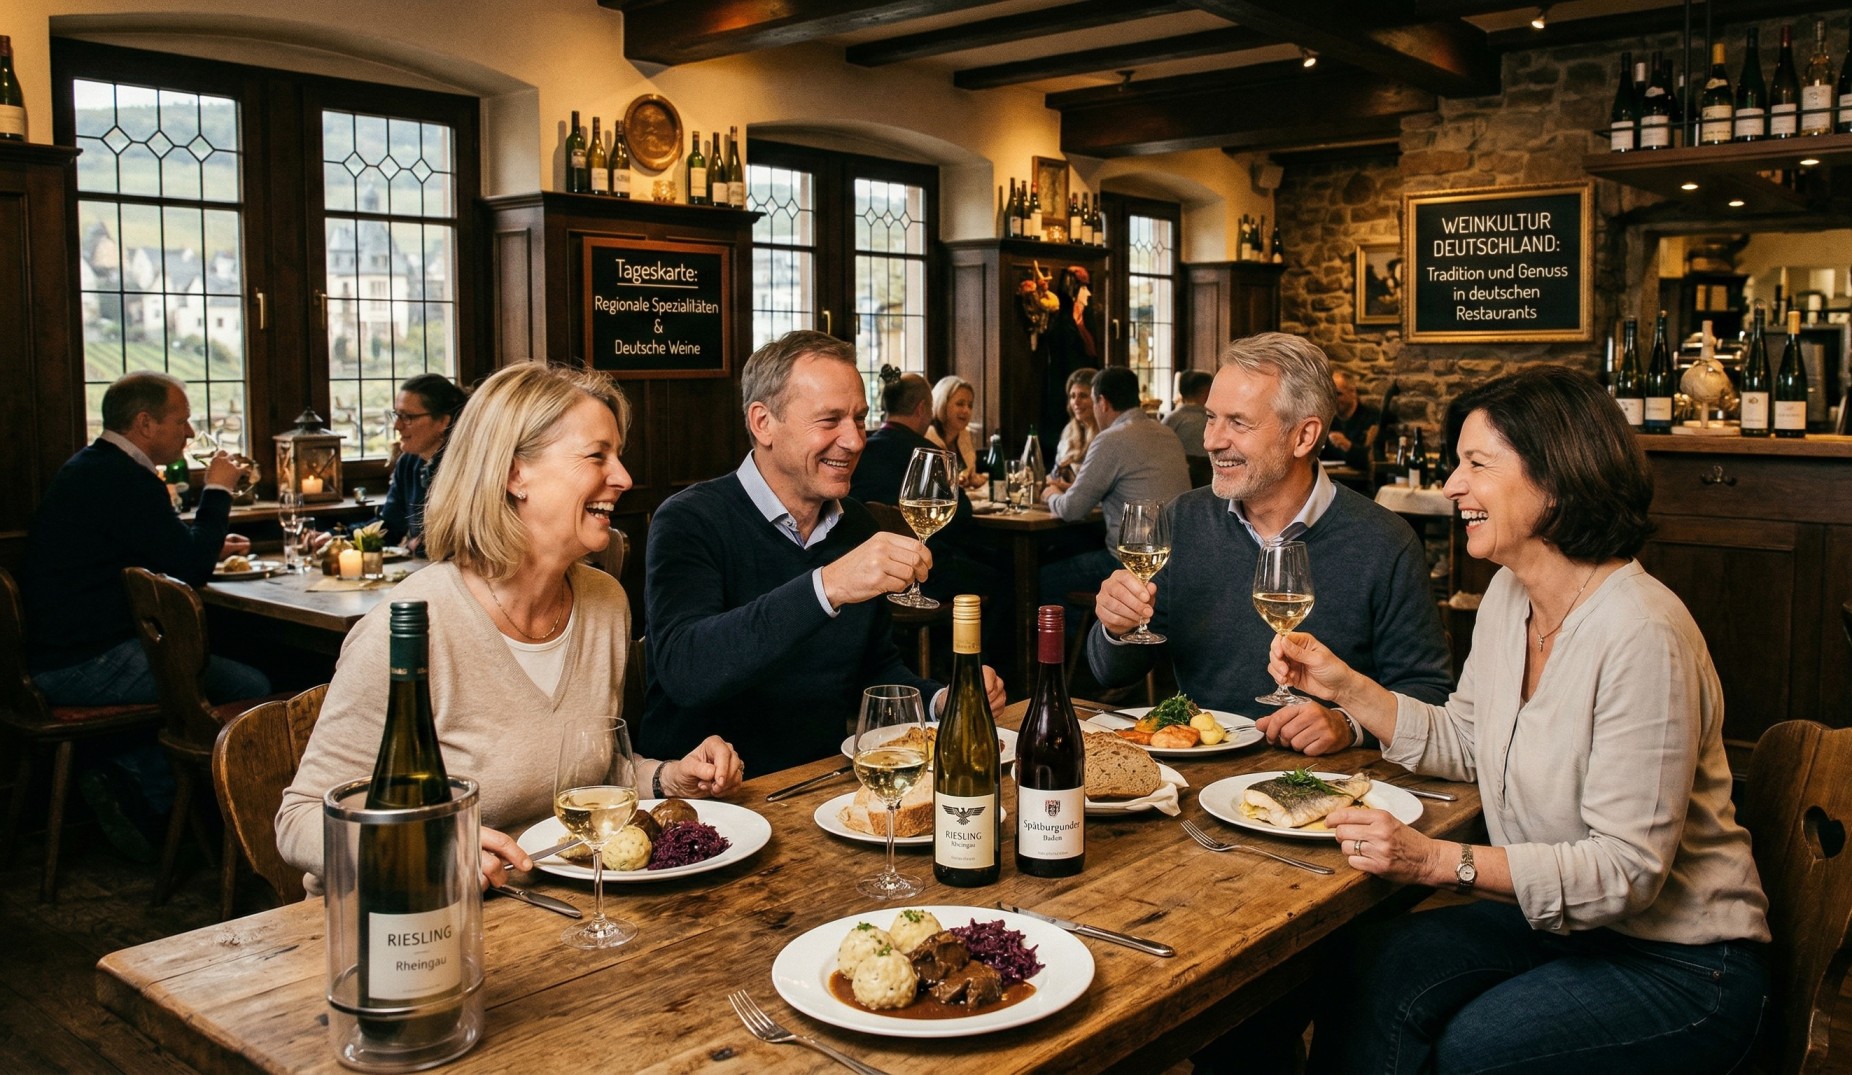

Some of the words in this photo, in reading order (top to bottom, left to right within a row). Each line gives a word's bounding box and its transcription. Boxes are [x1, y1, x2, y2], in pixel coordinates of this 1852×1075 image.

[1442, 212, 1550, 234] WEINKULTUR
[1434, 235, 1559, 257] DEUTSCHLAND:
[616, 258, 698, 284] Tageskarte:
[1427, 266, 1484, 281] Tradition
[1488, 264, 1514, 279] und
[1519, 264, 1568, 278] Genuss
[1454, 287, 1465, 300] in
[1469, 284, 1539, 300] deutschen
[595, 296, 649, 314] Regionale
[652, 298, 718, 315] Spezialitäten
[1457, 305, 1537, 320] Restaurants
[654, 319, 663, 333] &
[616, 340, 665, 354] Deutsche
[669, 341, 700, 354] Weine
[1023, 819, 1081, 834] Spätburgunder
[945, 830, 982, 841] RIESLING
[387, 924, 452, 947] RIESLING
[395, 956, 447, 972] Rheingau
